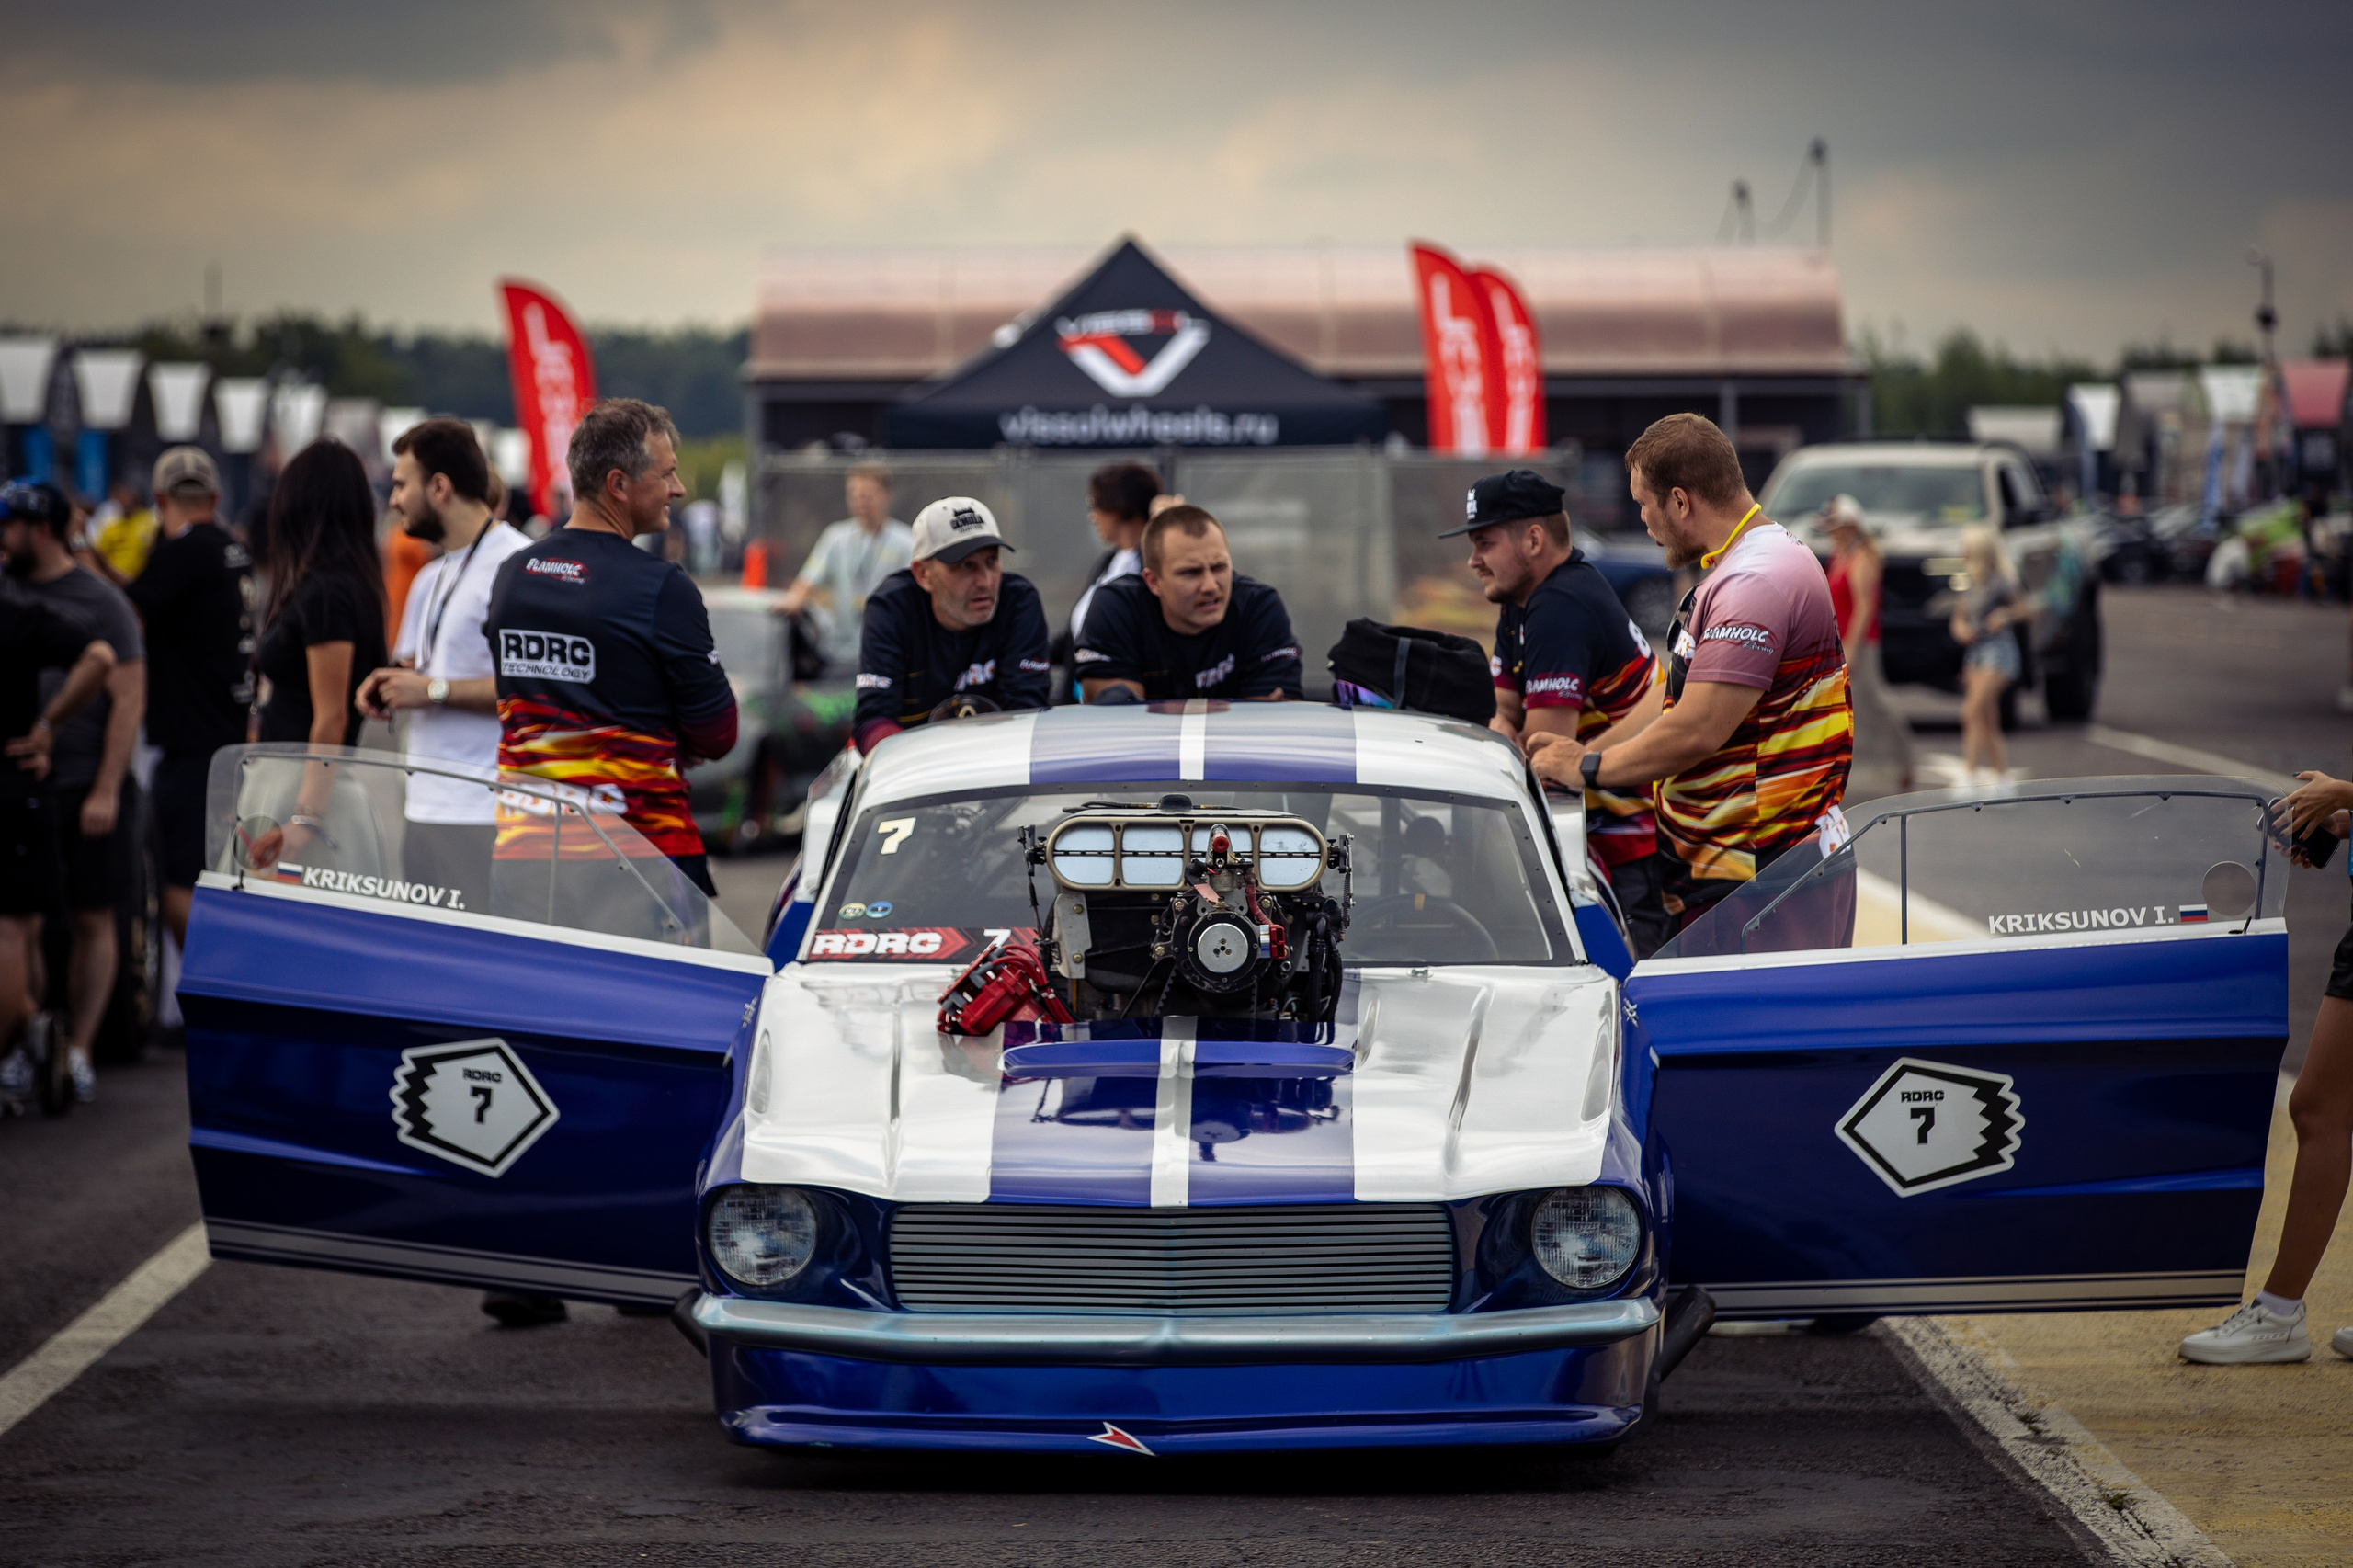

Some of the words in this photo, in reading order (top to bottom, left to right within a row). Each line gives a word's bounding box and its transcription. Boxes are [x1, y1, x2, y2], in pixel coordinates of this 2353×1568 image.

[505, 632, 591, 666] RDRC
[503, 663, 590, 679] TECHNOLOGY
[878, 817, 916, 855] 7
[302, 866, 446, 906] KRIKSUNOV
[446, 889, 466, 910] I.
[1988, 906, 2147, 934] KRIKSUNOV
[2154, 906, 2175, 925] I.
[811, 932, 943, 954] RDRC
[471, 1085, 493, 1124] 7
[1901, 1090, 1945, 1103] RDRC
[1910, 1106, 1936, 1145] 7
